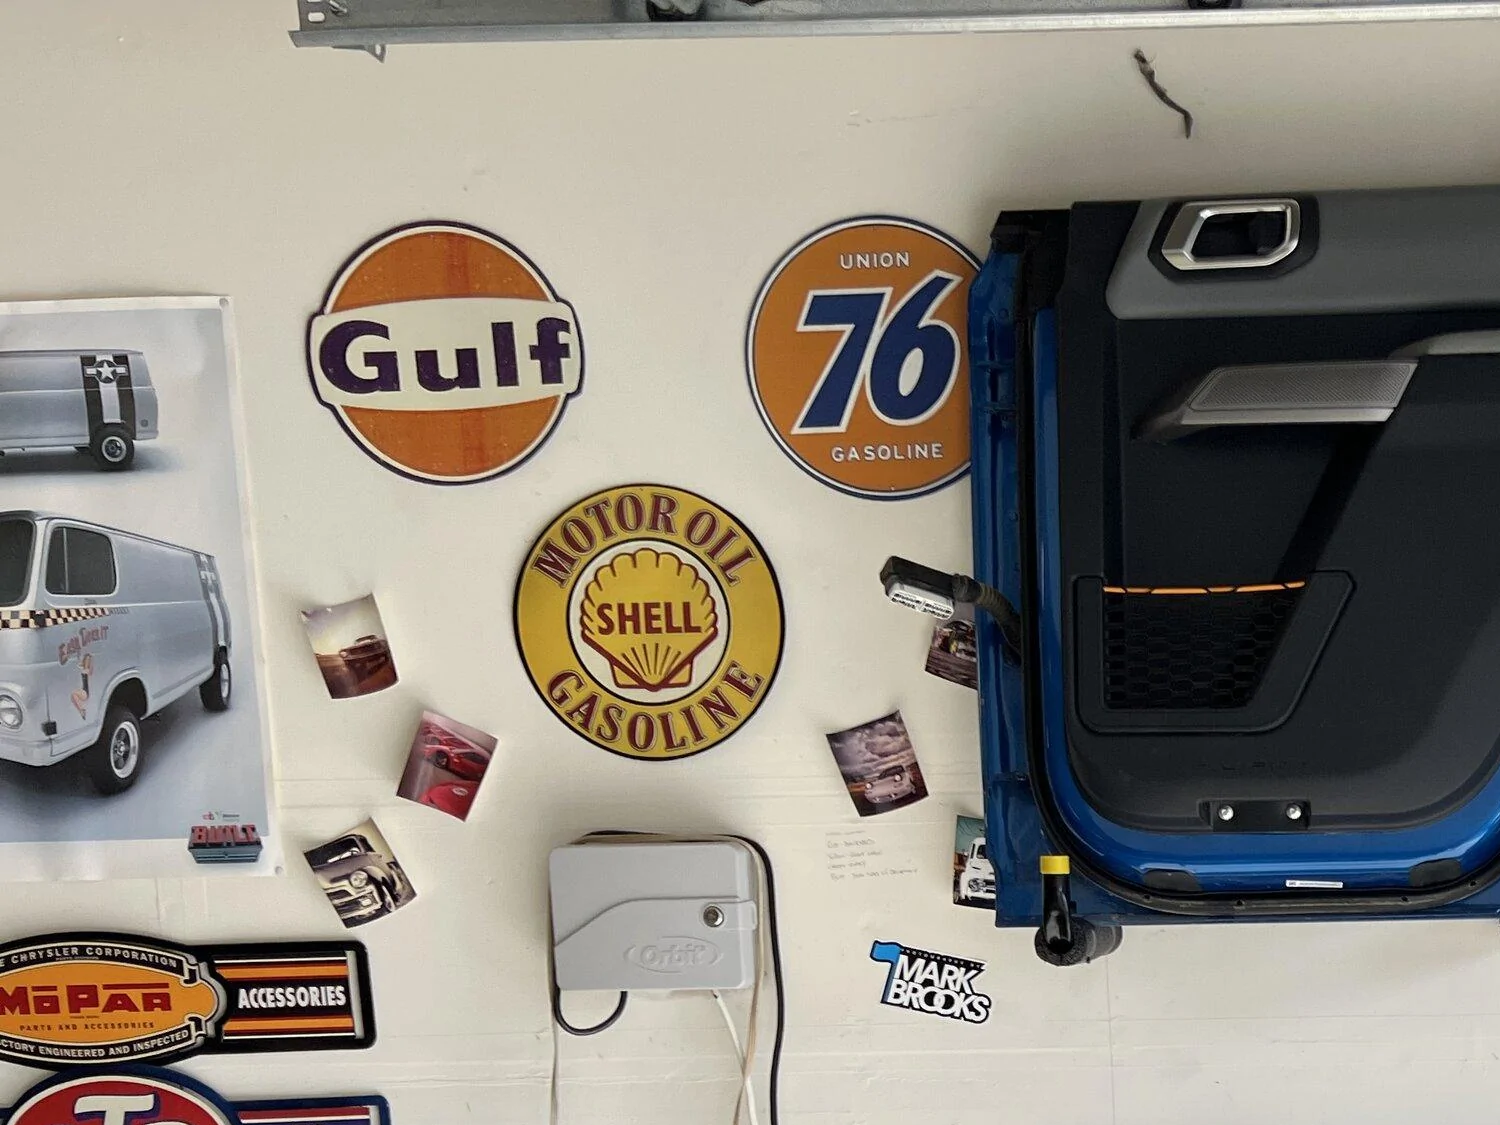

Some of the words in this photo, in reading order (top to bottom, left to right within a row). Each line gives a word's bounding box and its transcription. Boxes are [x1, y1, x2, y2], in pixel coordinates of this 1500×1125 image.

[840, 252, 910, 269] UNION
[319, 317, 571, 394] Gulf
[791, 269, 964, 435] 76
[831, 443, 944, 463] GASOLINE
[532, 491, 678, 588] MOTOR
[684, 508, 757, 587] OIL
[596, 601, 702, 636] SHELL
[547, 659, 765, 753] GASOLINE
[11, 946, 80, 965] CHRYSLER
[85, 947, 178, 968] CORPORATION
[894, 953, 979, 996] MARK
[237, 985, 347, 1009] ACCESSORIES
[886, 978, 990, 1022] BROOKS
[0, 1038, 37, 1053] CTORY
[39, 1046, 106, 1058] ENGINEERED
[108, 1045, 130, 1056] AND
[133, 1029, 189, 1051] INSPECTED
[20, 1024, 52, 1032] PARTS
[58, 1023, 78, 1031] AND
[84, 1021, 154, 1031] ACCESSORIES
